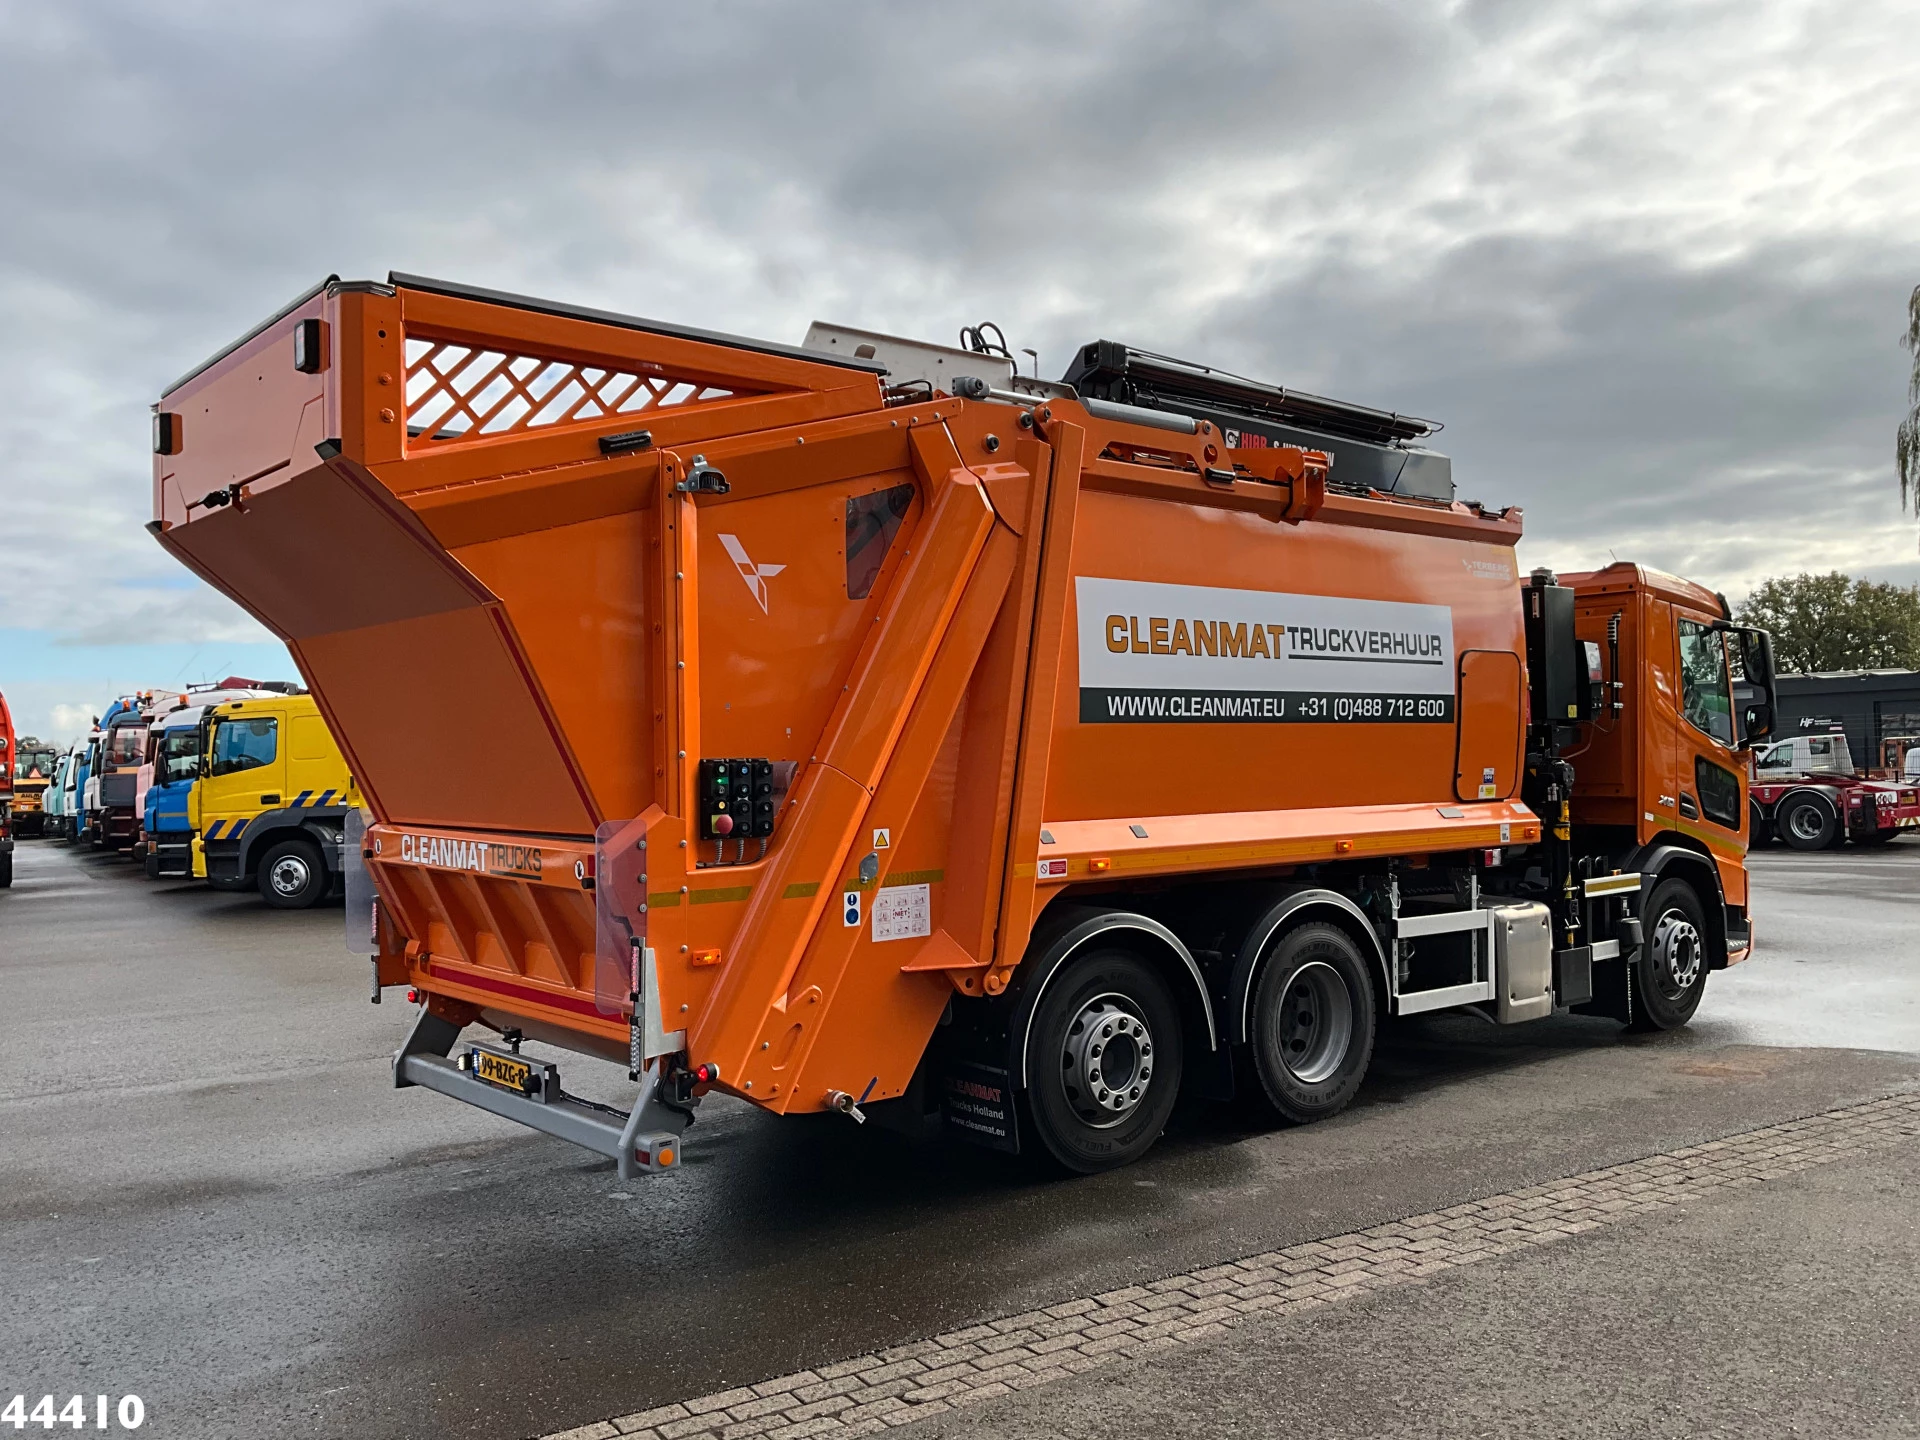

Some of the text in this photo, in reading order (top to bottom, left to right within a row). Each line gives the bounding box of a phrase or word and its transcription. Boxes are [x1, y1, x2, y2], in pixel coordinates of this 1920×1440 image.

[1241, 432, 1268, 449] HIAB
[1105, 615, 1442, 659] CLEANMAT TRUCKVERHUUR
[1107, 696, 1445, 720] WWW.CLEANMAT.EU +31 (0)488 712 600
[1800, 717, 1815, 727] HF
[401, 834, 542, 872] CLEANMAT TRUCKS
[894, 909, 908, 917] NIET
[973, 1104, 1004, 1119] Holland
[951, 1116, 1006, 1137] www.cleanmat.eu
